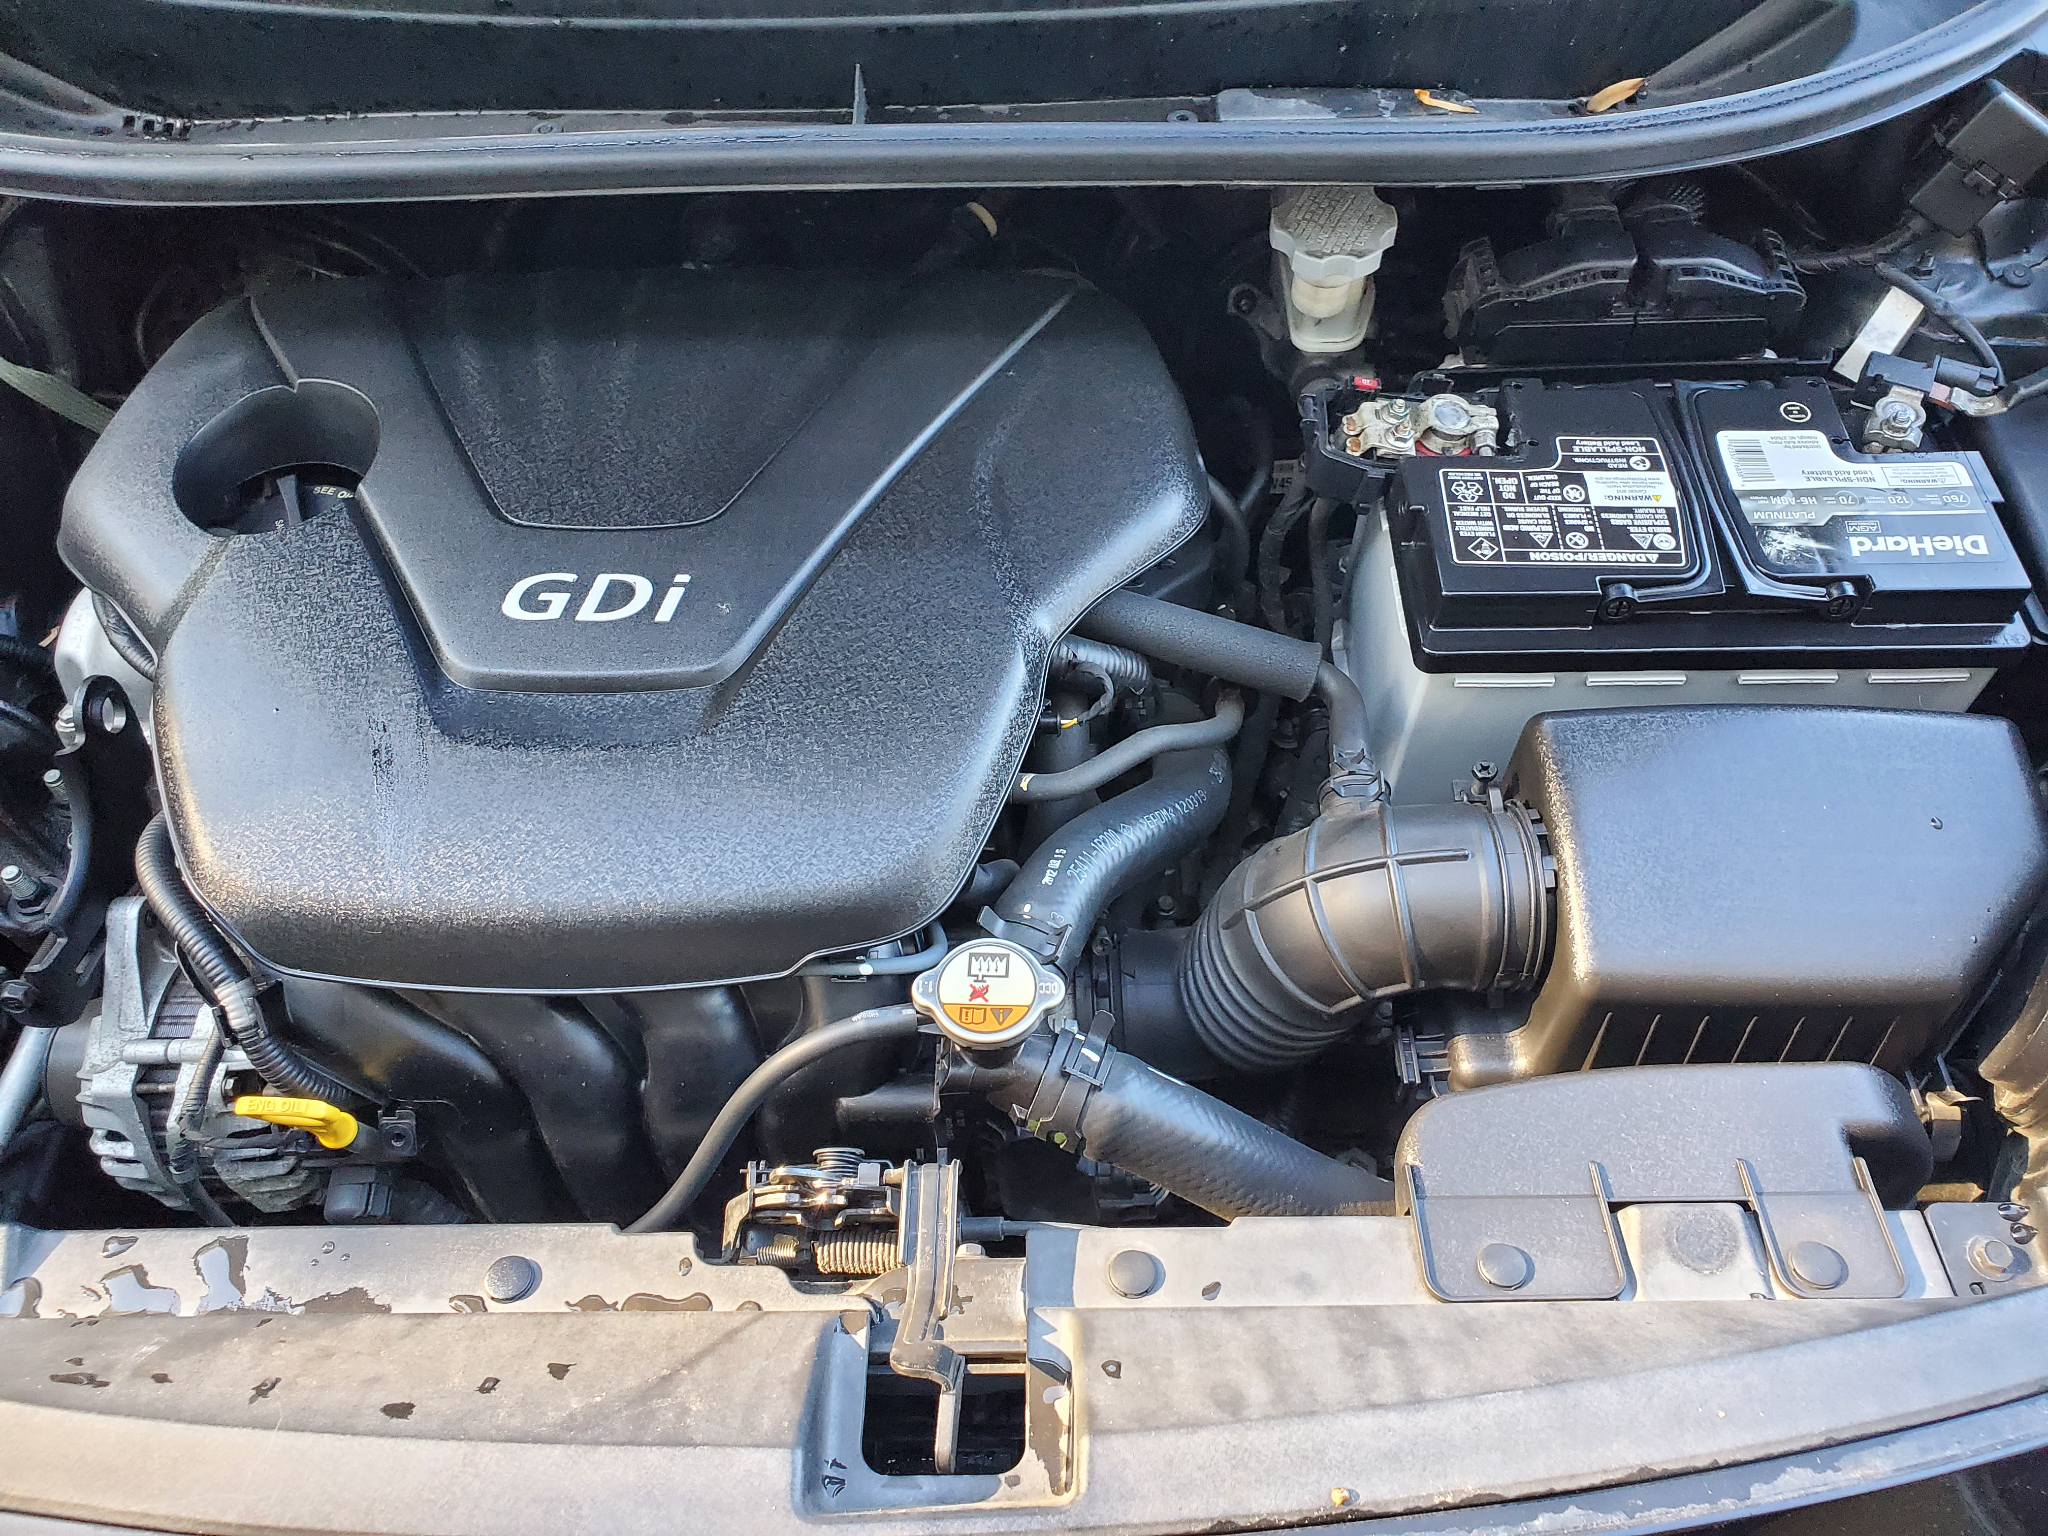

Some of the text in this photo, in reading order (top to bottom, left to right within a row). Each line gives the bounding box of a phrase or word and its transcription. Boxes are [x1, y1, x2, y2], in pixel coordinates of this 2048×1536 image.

[312, 486, 337, 496] SEE
[1502, 492, 1516, 500] DO
[1770, 495, 1817, 505] H6-AGM
[1838, 496, 1856, 504] 70
[1888, 495, 1910, 504] 120
[1942, 494, 1968, 503] 760
[1753, 511, 1816, 520] PLATINUM
[1529, 552, 1647, 562] DANGER/POISON
[501, 572, 692, 623] GDi
[918, 980, 934, 994] 1.1
[246, 1098, 306, 1114] ENG OIL
